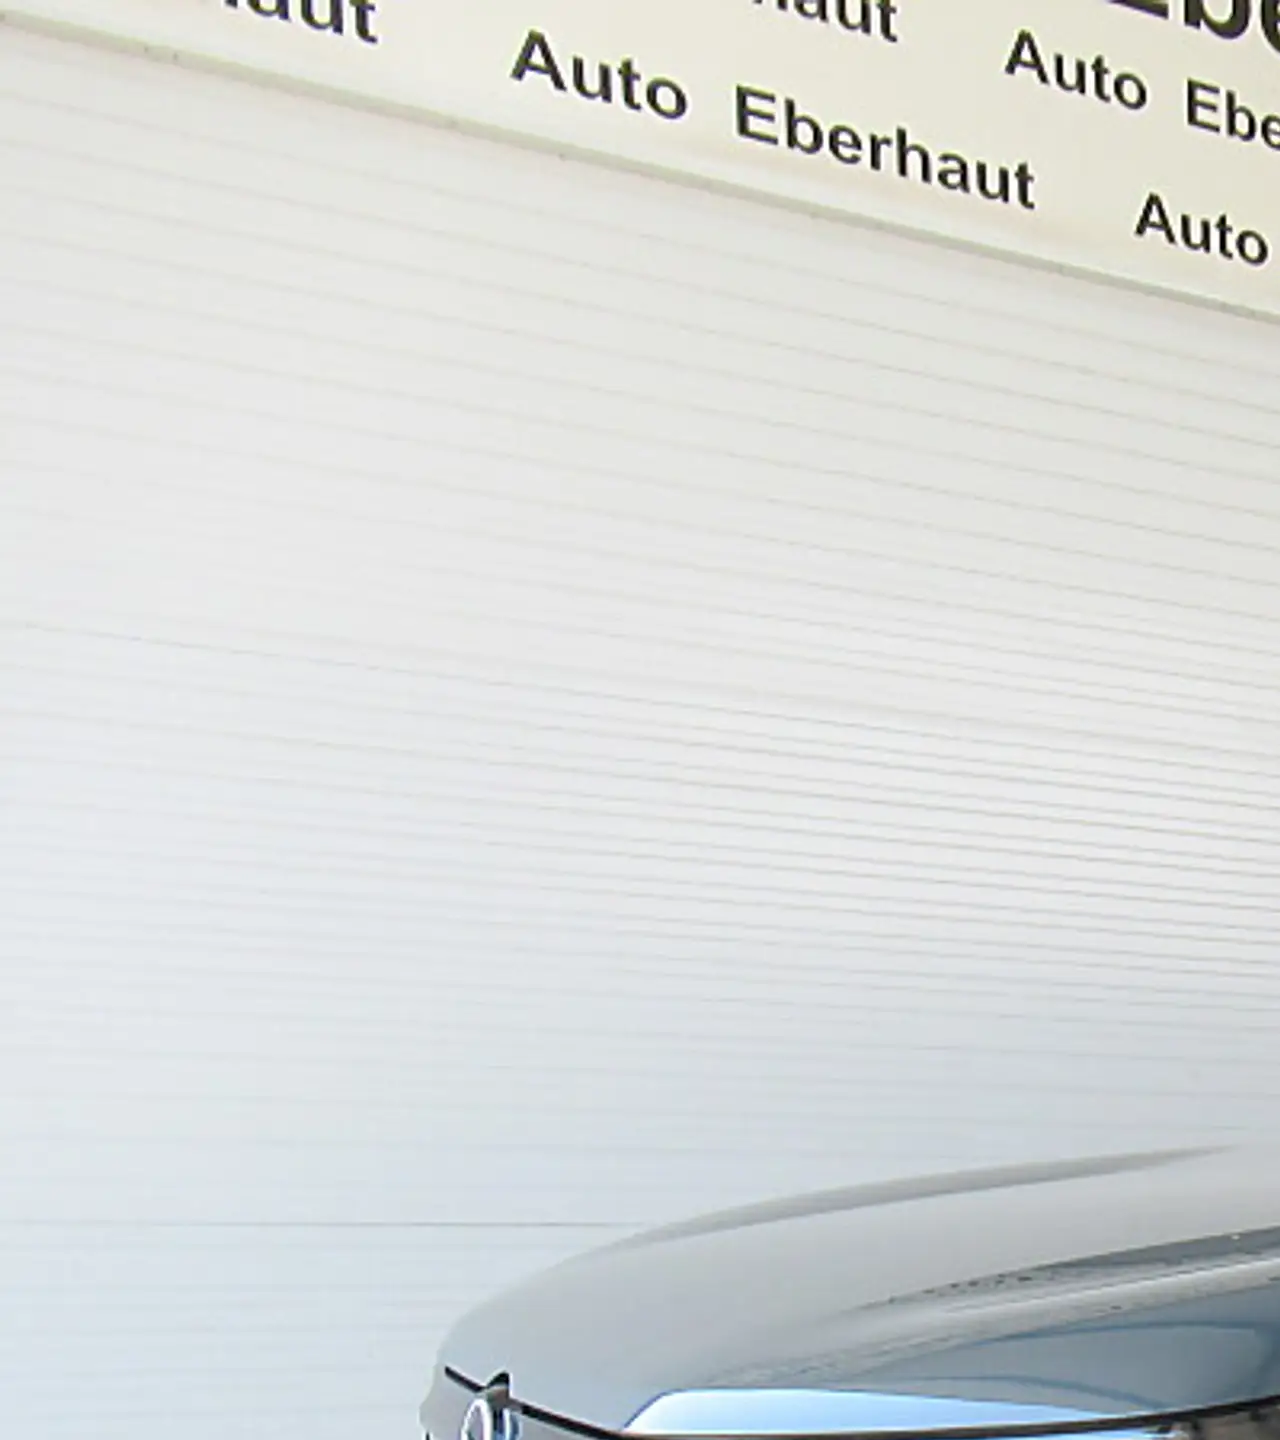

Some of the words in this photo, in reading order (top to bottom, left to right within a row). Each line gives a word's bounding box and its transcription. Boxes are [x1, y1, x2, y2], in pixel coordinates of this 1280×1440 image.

[1006, 31, 1148, 110] Auto
[512, 32, 687, 120] Auto
[736, 86, 1035, 210] Eberhaut
[1136, 194, 1268, 266] Auto
